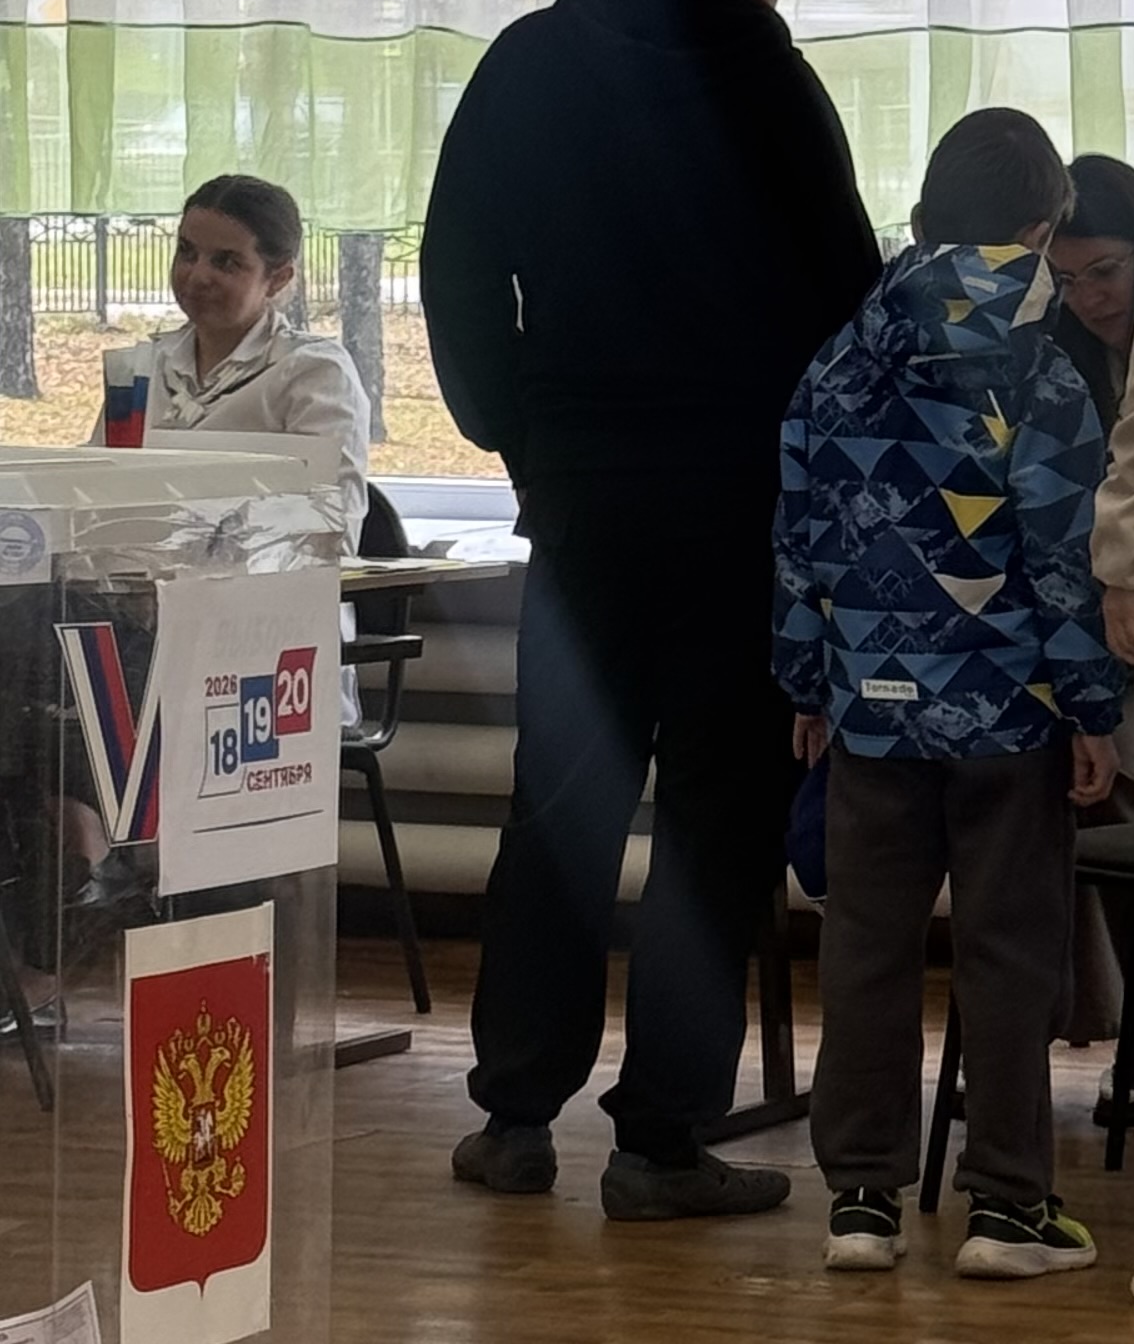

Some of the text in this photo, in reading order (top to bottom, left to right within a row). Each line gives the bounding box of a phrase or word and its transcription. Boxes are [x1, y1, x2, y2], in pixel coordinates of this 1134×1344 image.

[204, 674, 238, 698] 2026
[210, 667, 309, 776] 18 19 20
[246, 762, 312, 792] СЕНТЯБРЯ
